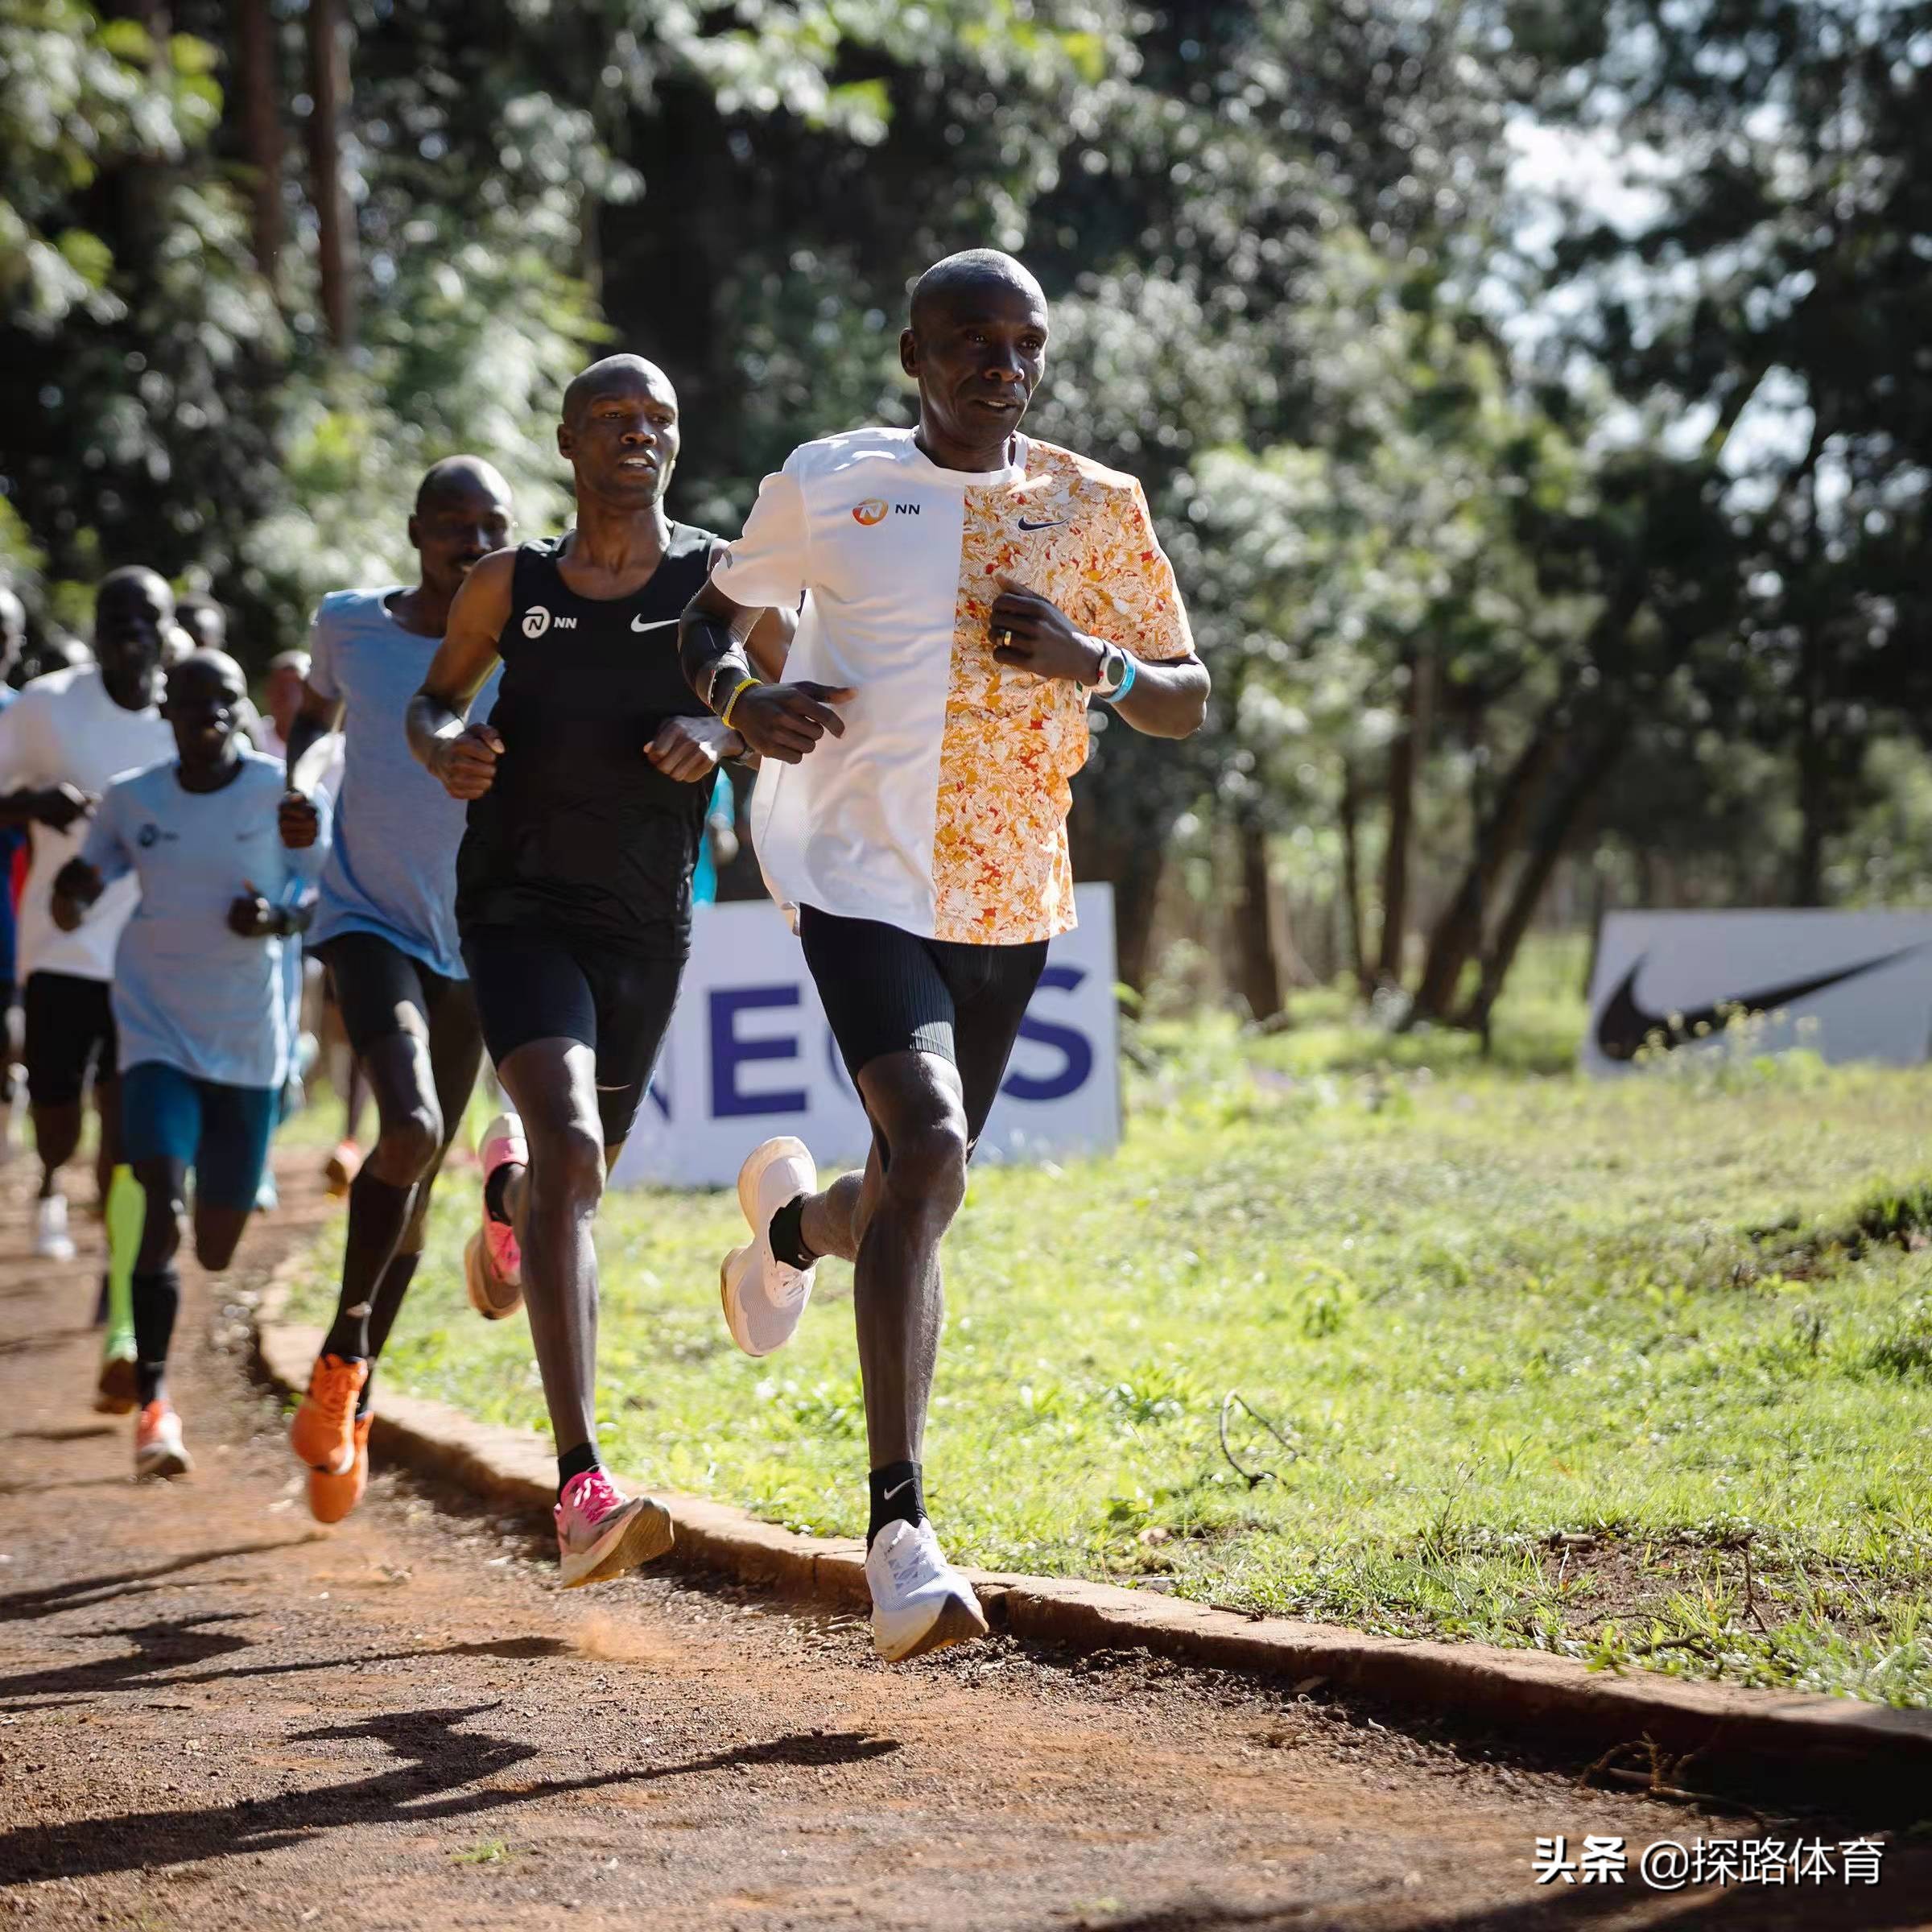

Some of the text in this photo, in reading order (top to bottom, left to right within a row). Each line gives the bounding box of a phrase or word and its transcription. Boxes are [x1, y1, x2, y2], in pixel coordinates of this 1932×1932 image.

[894, 504, 920, 515] NN
[554, 617, 578, 630] NN
[646, 966, 1093, 1121] ES
